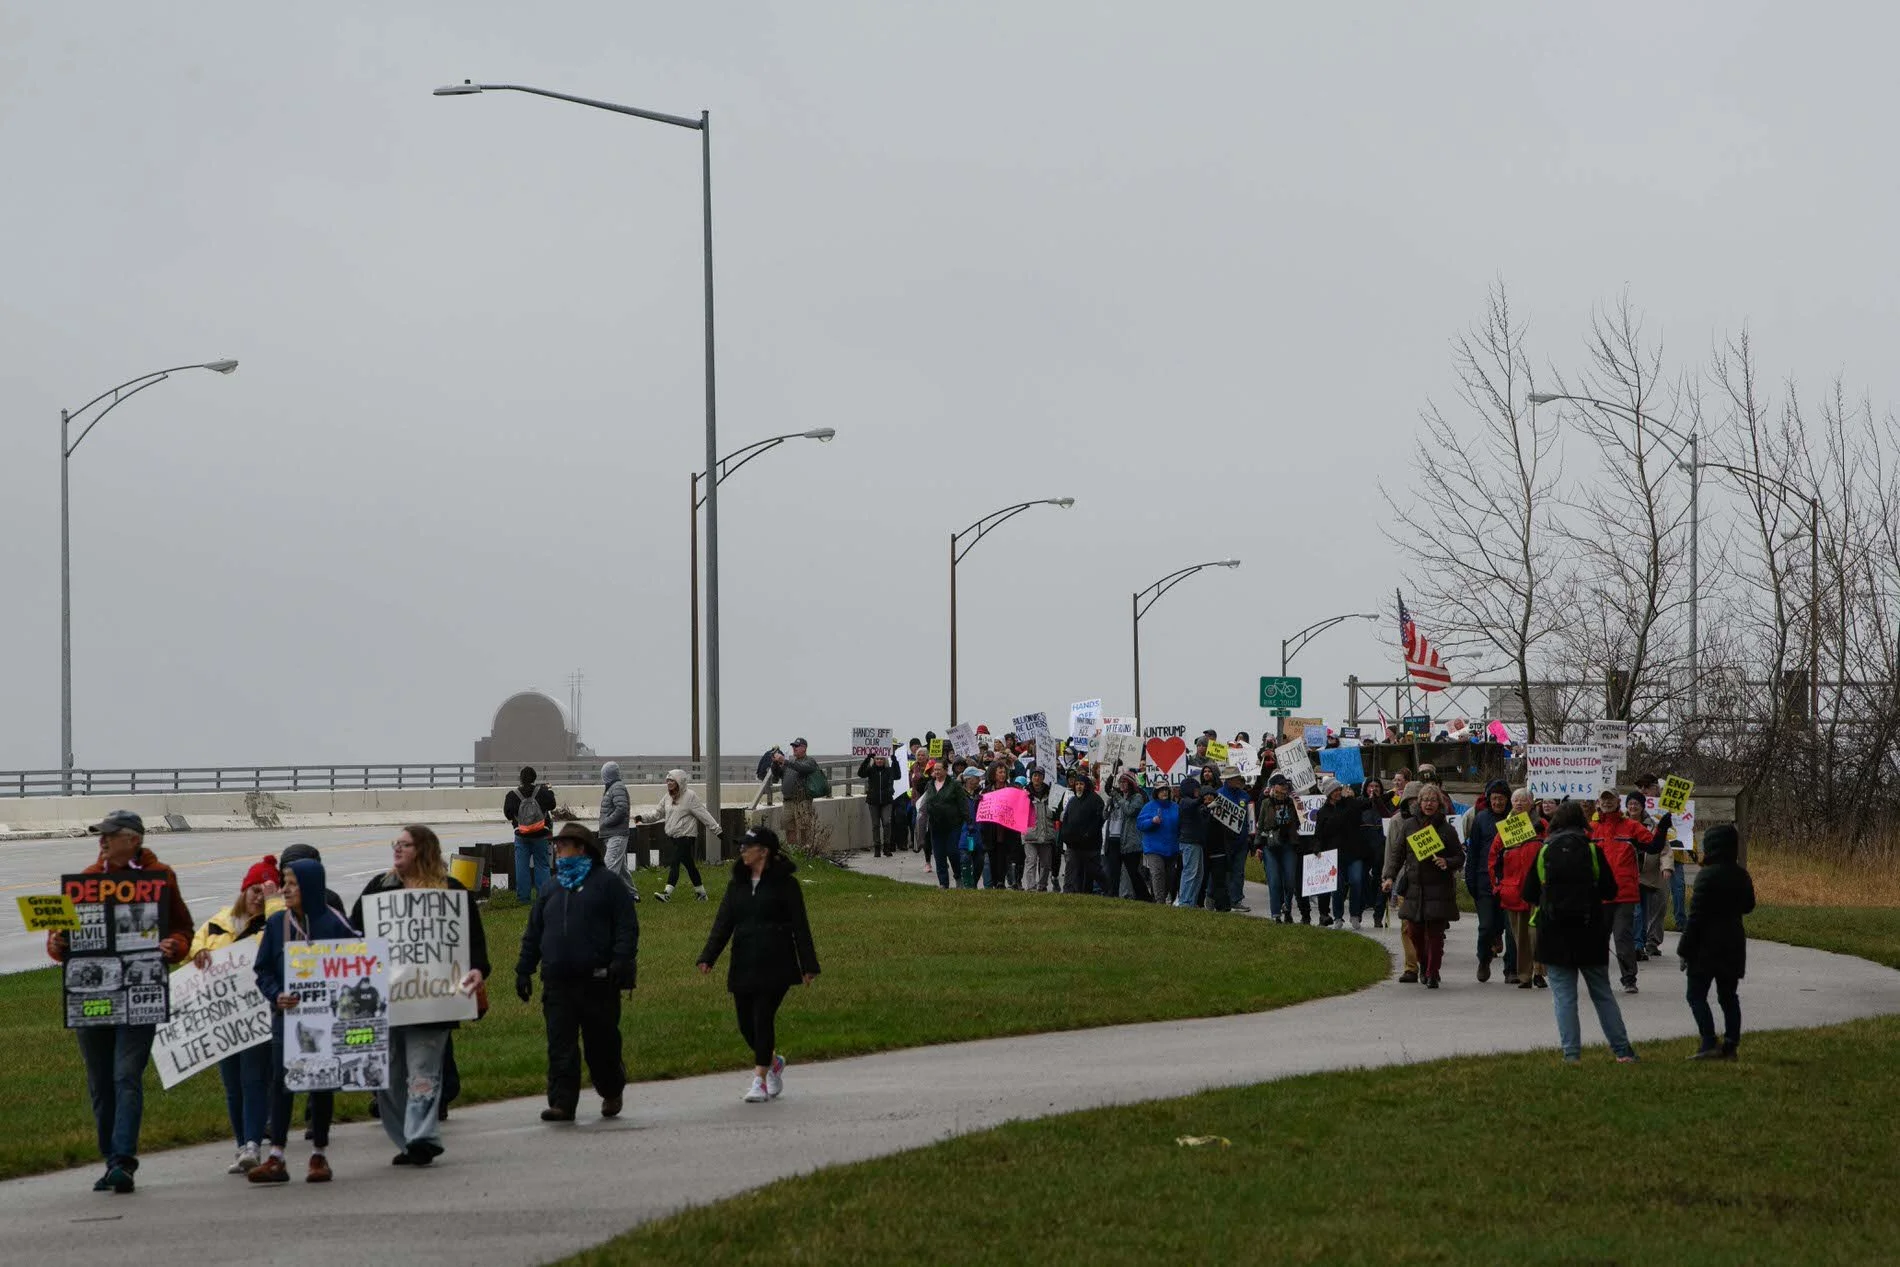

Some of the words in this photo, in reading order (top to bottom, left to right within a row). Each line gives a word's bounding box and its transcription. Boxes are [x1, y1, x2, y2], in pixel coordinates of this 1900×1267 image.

[1072, 700, 1100, 711] HANDS
[852, 728, 876, 738] HANDS
[877, 728, 890, 737] OFF
[1146, 725, 1186, 738] UNTRUMP
[865, 738, 880, 746] OUR
[852, 746, 892, 757] DEMOCRACY
[1528, 757, 1561, 768] WRONG
[1146, 773, 1187, 787] WORLD
[1667, 778, 1690, 790] END
[1530, 781, 1593, 793] ANSWERS
[1665, 788, 1686, 799] REX
[1215, 795, 1246, 817] HANDS
[1661, 799, 1682, 811] LEX
[1506, 816, 1520, 825] BAN
[1504, 822, 1527, 832] BOMBS
[1511, 828, 1524, 837] NOT
[1412, 830, 1431, 842] Grow
[1417, 836, 1434, 848] DEM
[1505, 830, 1536, 847] REFUGEES
[1418, 843, 1441, 857] Spines
[65, 880, 166, 903] DEPORT
[28, 896, 62, 905] Grow
[378, 891, 460, 920] HUMAN
[34, 907, 64, 915] DEM
[31, 918, 74, 927] Spines
[72, 927, 105, 940] CIVIL
[378, 919, 460, 944] RIGHTS
[72, 939, 106, 950] RIGHTS
[197, 975, 238, 1005] NOT
[289, 981, 326, 990] HANDS
[132, 994, 162, 1003] OFF!
[129, 1007, 165, 1015] VETERAN
[156, 1020, 180, 1046] THE
[183, 997, 239, 1036] REASON
[171, 1033, 215, 1073] LIFE
[213, 1011, 271, 1051] SUCKS
